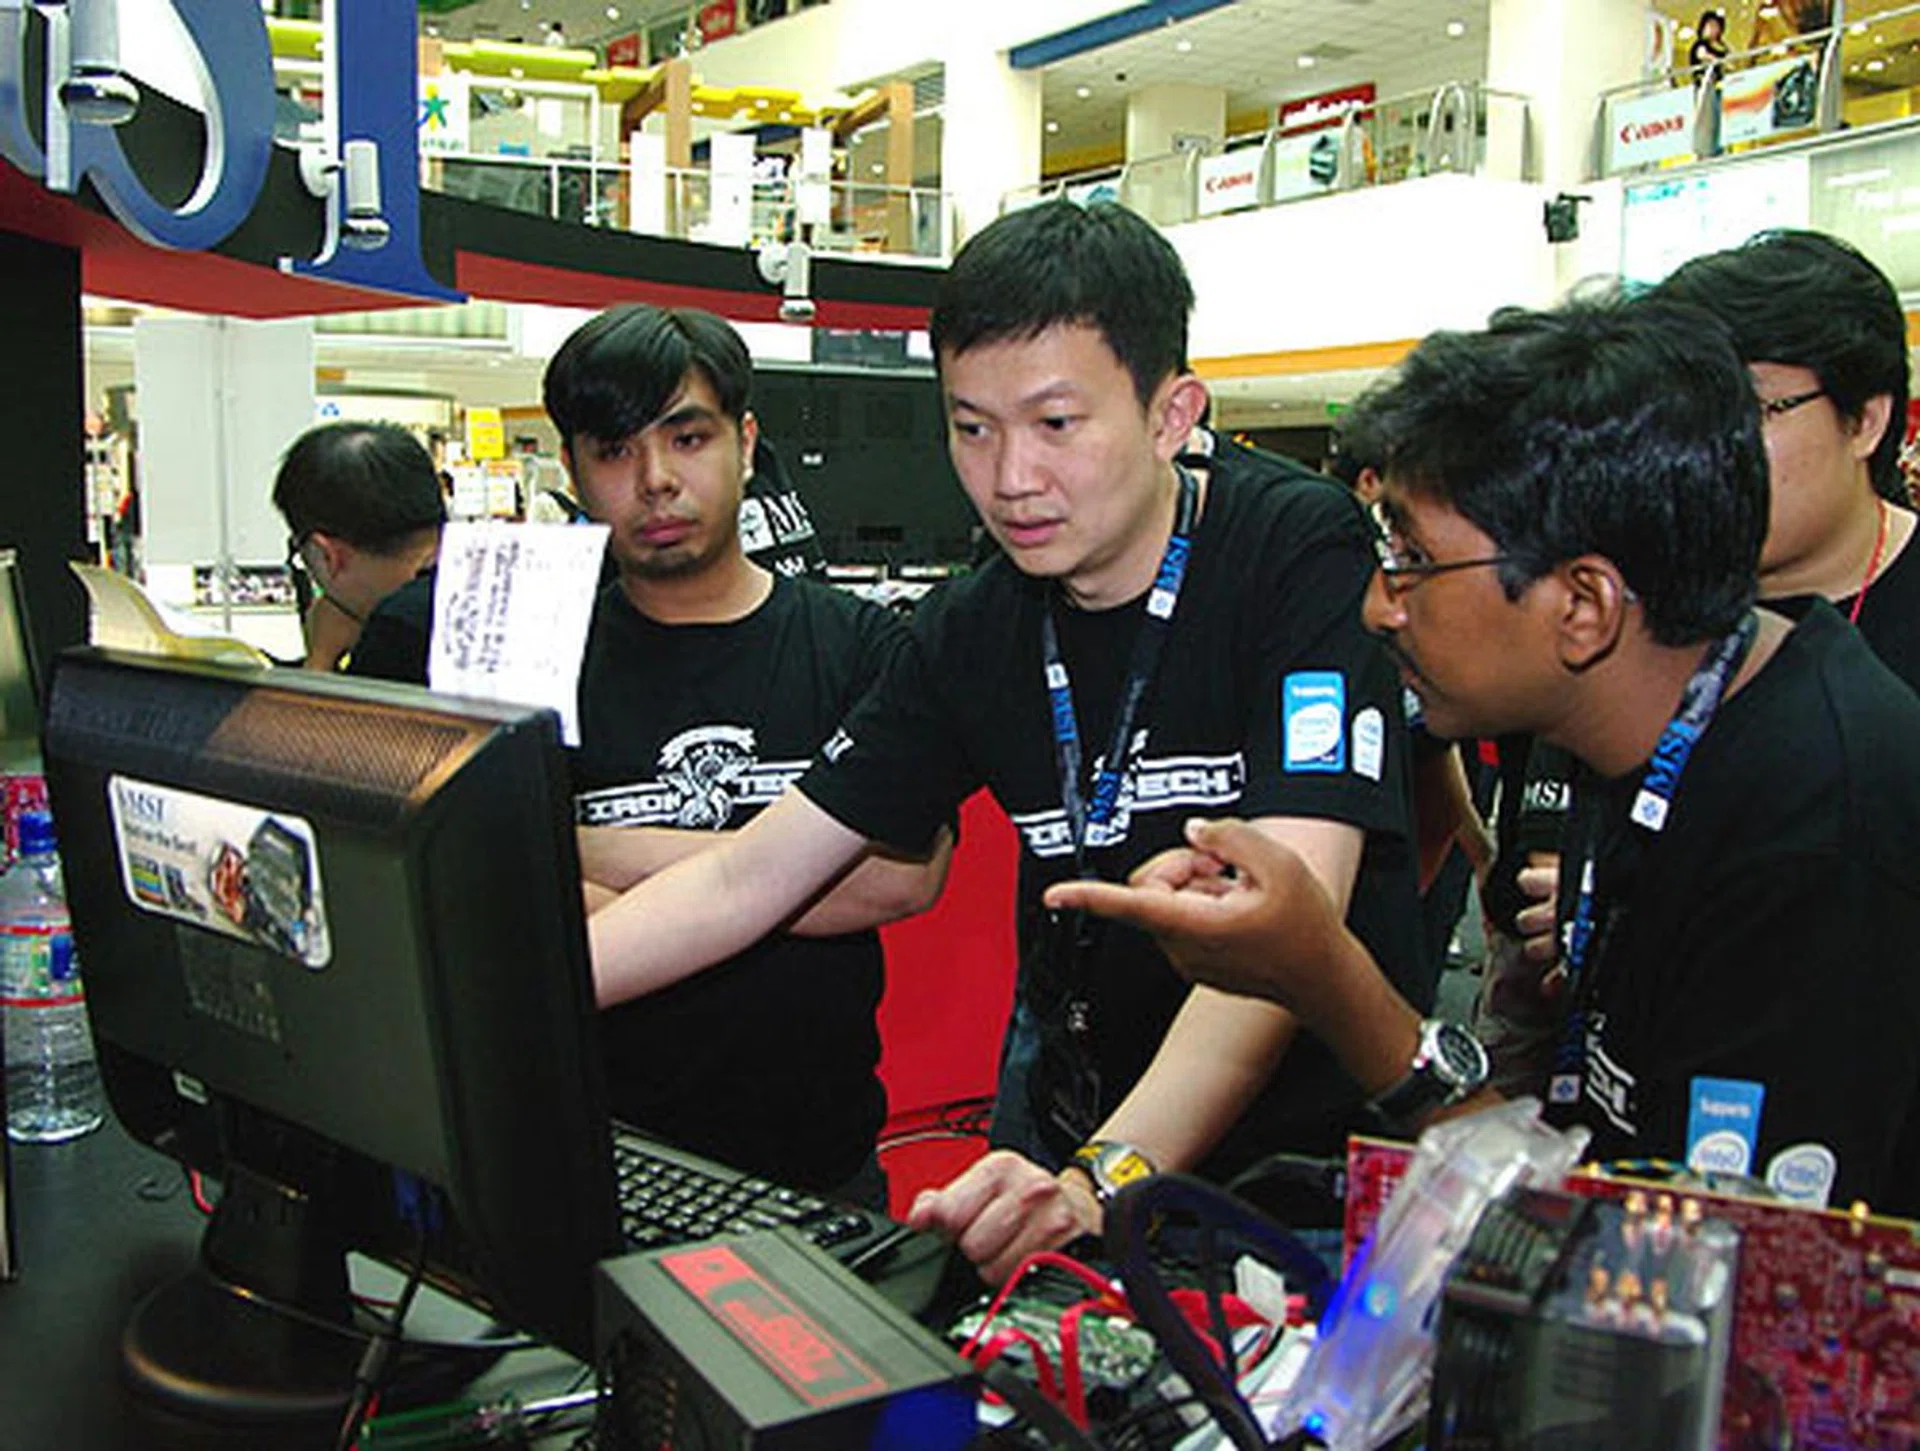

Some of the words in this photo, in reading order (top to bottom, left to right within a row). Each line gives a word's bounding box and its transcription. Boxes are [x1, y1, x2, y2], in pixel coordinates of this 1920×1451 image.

[1620, 114, 1684, 144] Canon
[1206, 172, 1253, 193] Canon
[1642, 718, 1701, 801] MSI
